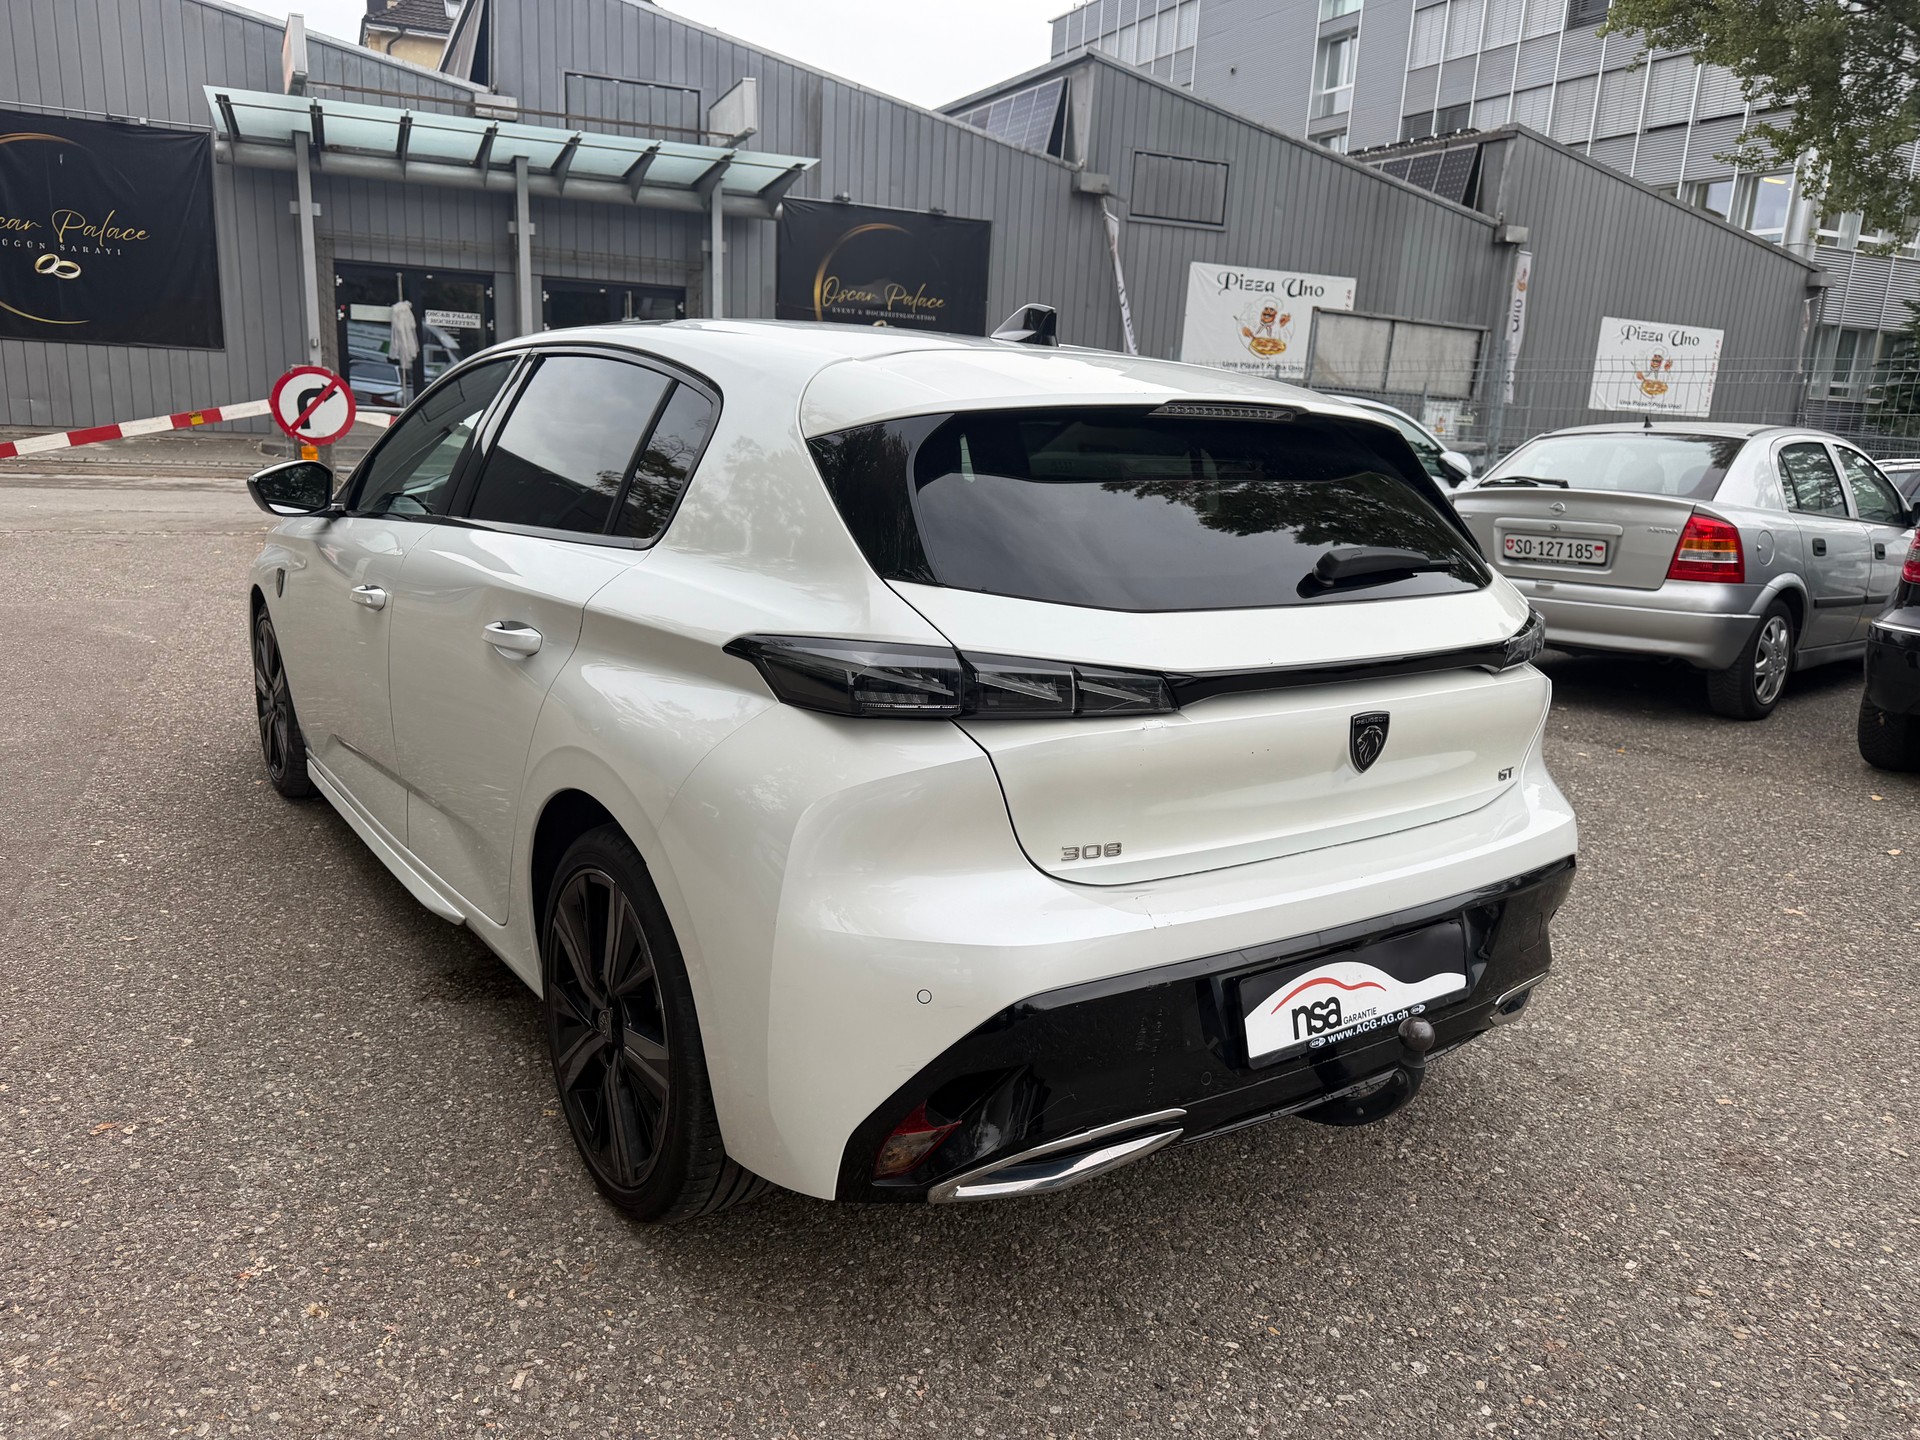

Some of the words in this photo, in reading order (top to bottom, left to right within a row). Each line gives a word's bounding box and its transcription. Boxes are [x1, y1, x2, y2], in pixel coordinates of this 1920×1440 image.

[52, 209, 150, 247] Palace
[60, 244, 121, 255] SARAYI
[822, 276, 880, 307] Oscar
[884, 283, 945, 313] Palace
[1217, 271, 1275, 296] Pizza
[1282, 277, 1325, 298] Uno
[1620, 324, 1664, 346] Pizza
[1668, 329, 1700, 347] Uno
[1356, 716, 1387, 725] PEUGEOT
[1498, 766, 1514, 781] GT
[1061, 842, 1122, 861] 308
[1291, 996, 1342, 1040] nsa
[1343, 1007, 1377, 1025] GARANTIE
[1327, 1009, 1409, 1044] www.ACG-AG.ch
